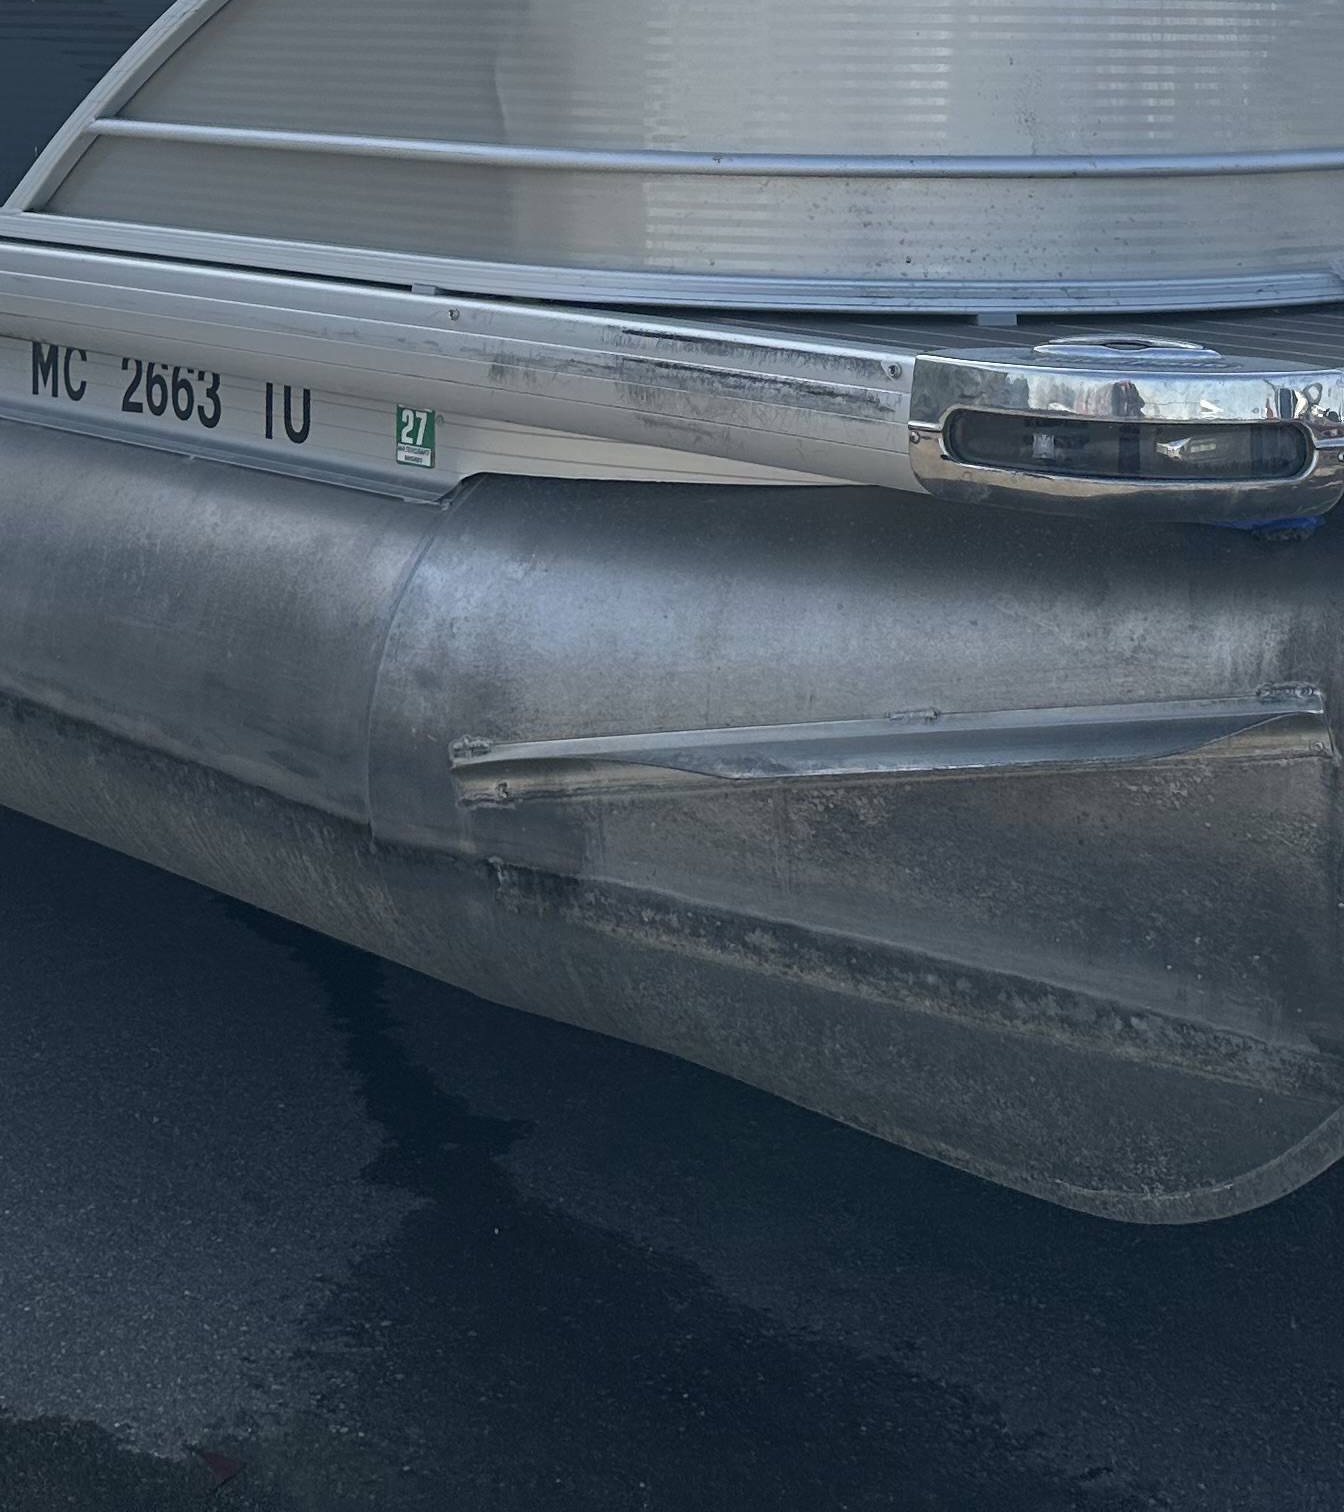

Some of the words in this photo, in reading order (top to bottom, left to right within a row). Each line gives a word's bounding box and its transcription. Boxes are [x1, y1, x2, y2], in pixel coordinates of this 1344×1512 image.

[32, 341, 87, 401] MC
[121, 357, 222, 429] 2663
[401, 409, 427, 445] 27
